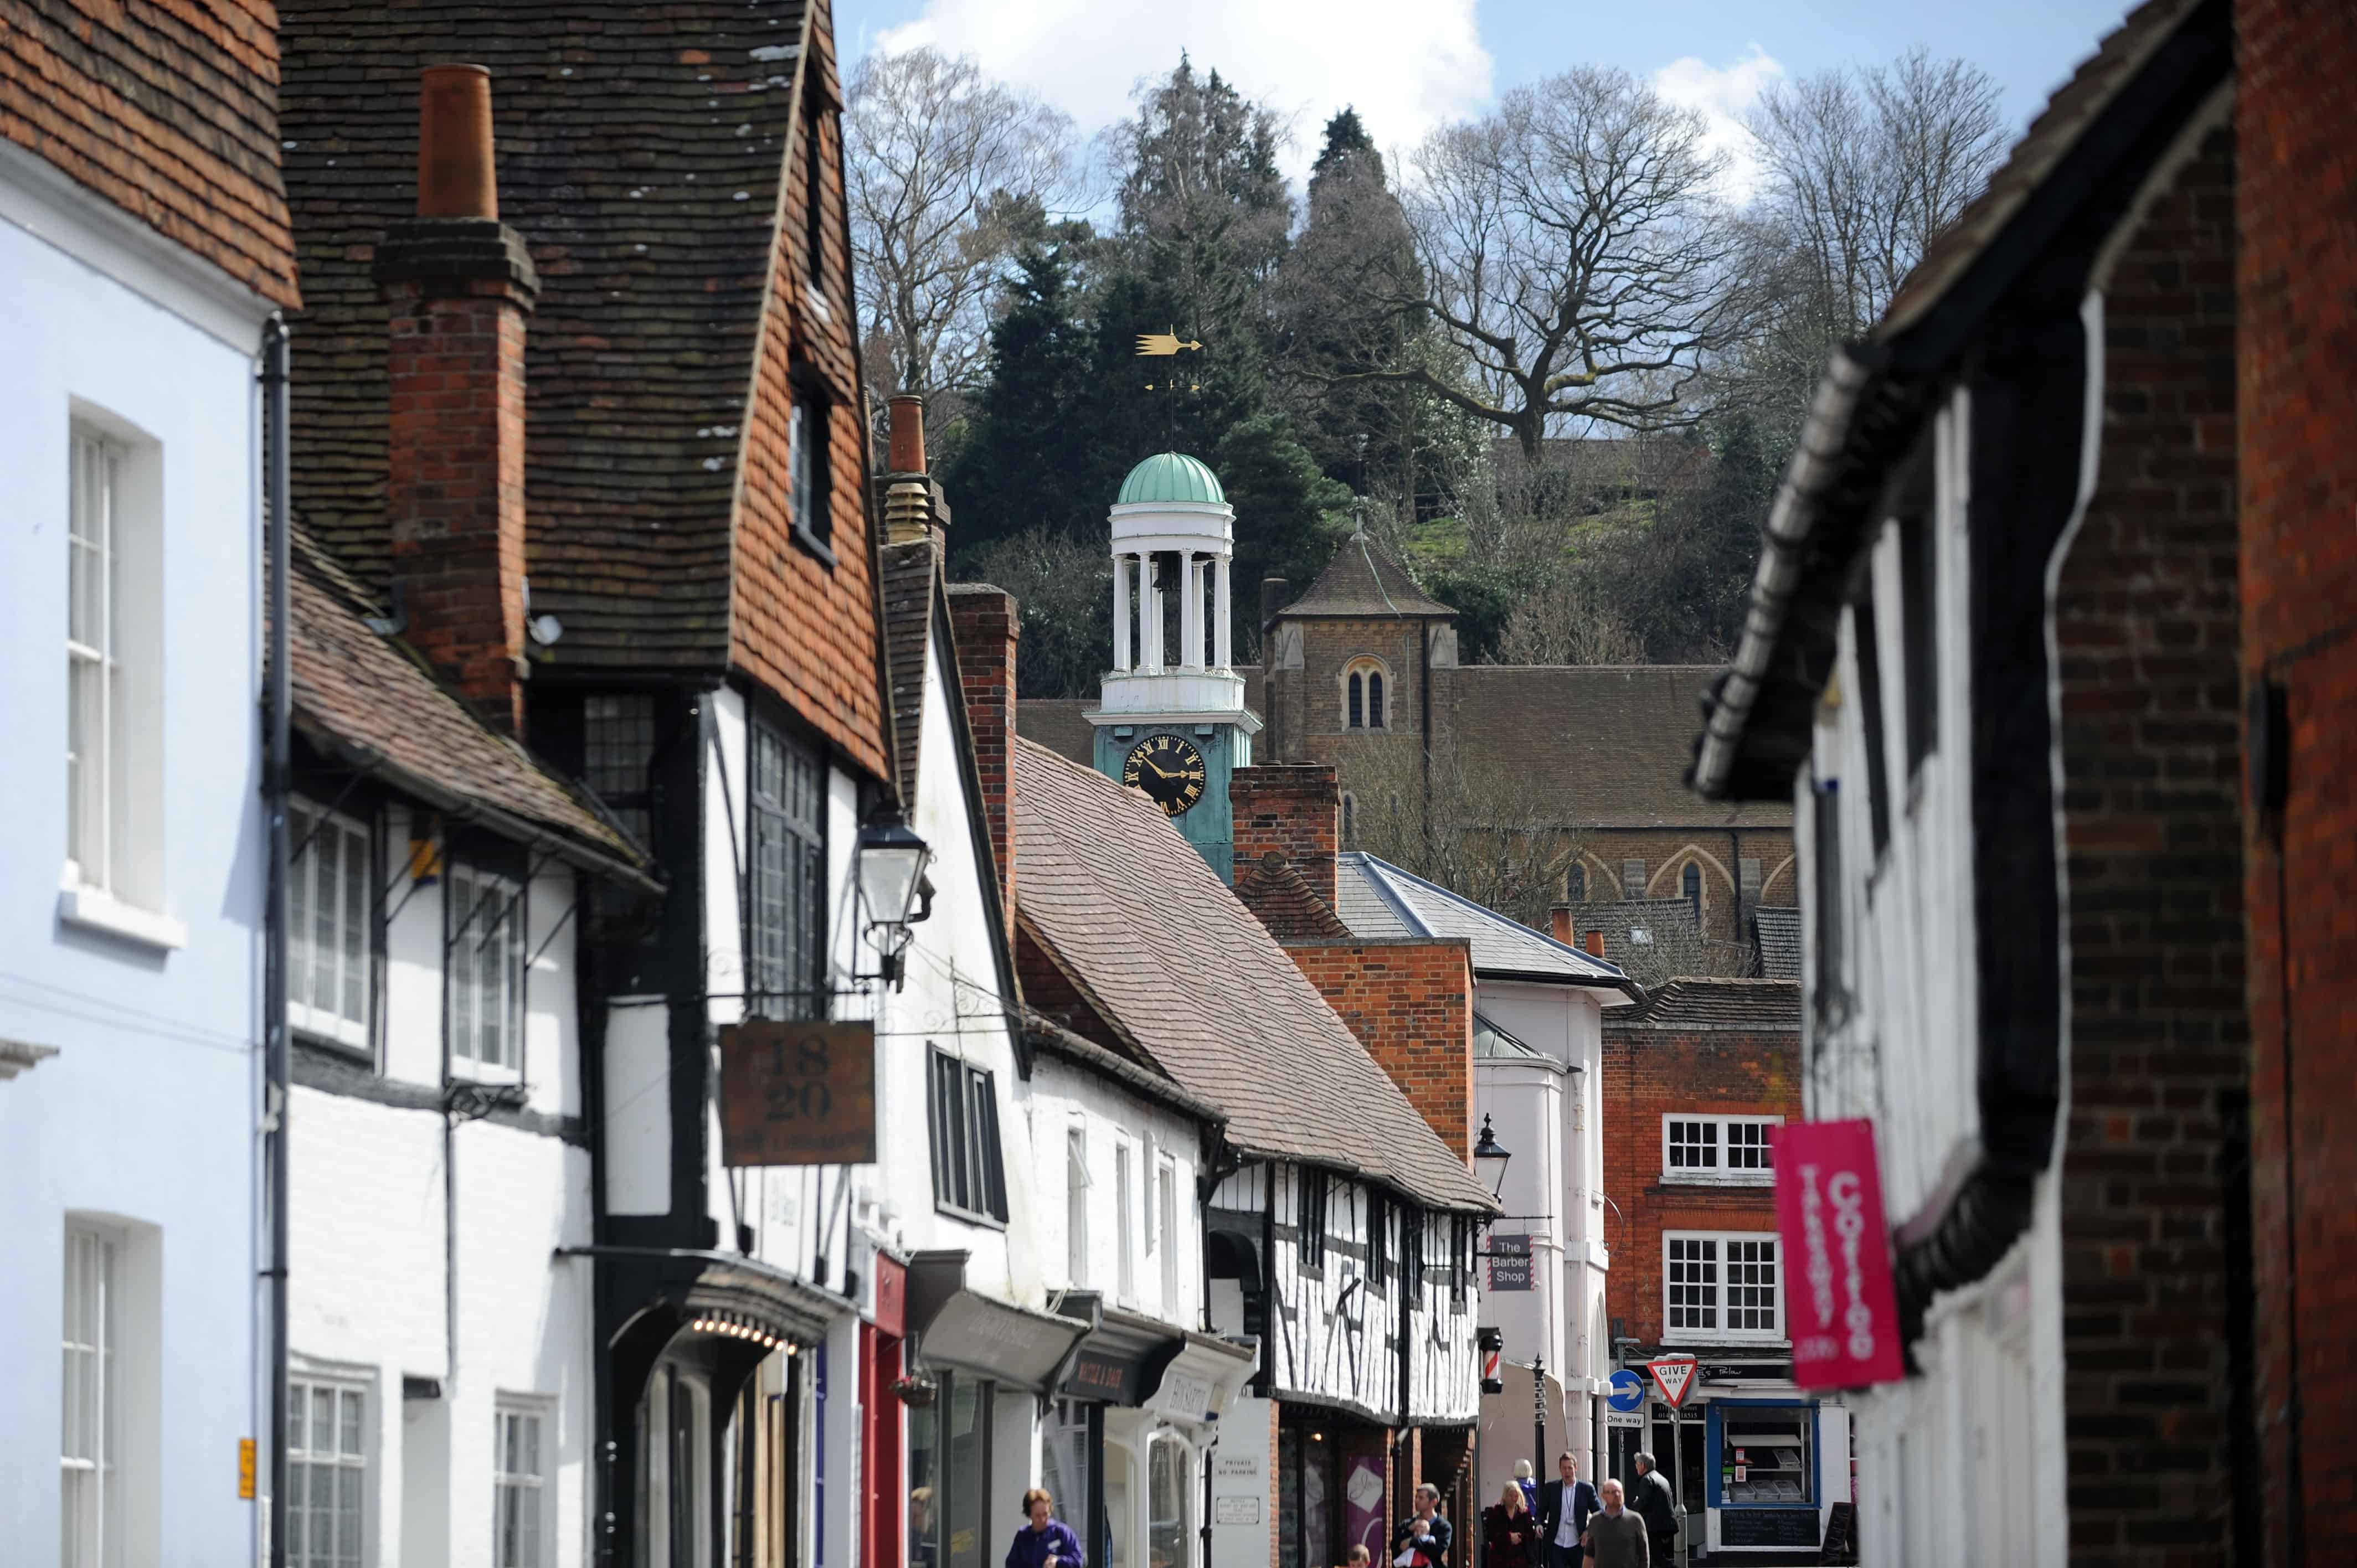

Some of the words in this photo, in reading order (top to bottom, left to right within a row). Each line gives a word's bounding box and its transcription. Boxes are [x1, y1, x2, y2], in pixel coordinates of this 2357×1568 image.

[1158, 739, 1169, 750] XII
[1186, 755, 1196, 765] II
[1189, 771, 1201, 780] III
[1500, 1242, 1520, 1252] The
[1493, 1257, 1529, 1267] Barber
[1497, 1271, 1525, 1283] Shop
[1659, 1366, 1687, 1375] GIVE
[1625, 1417, 1641, 1426] way
